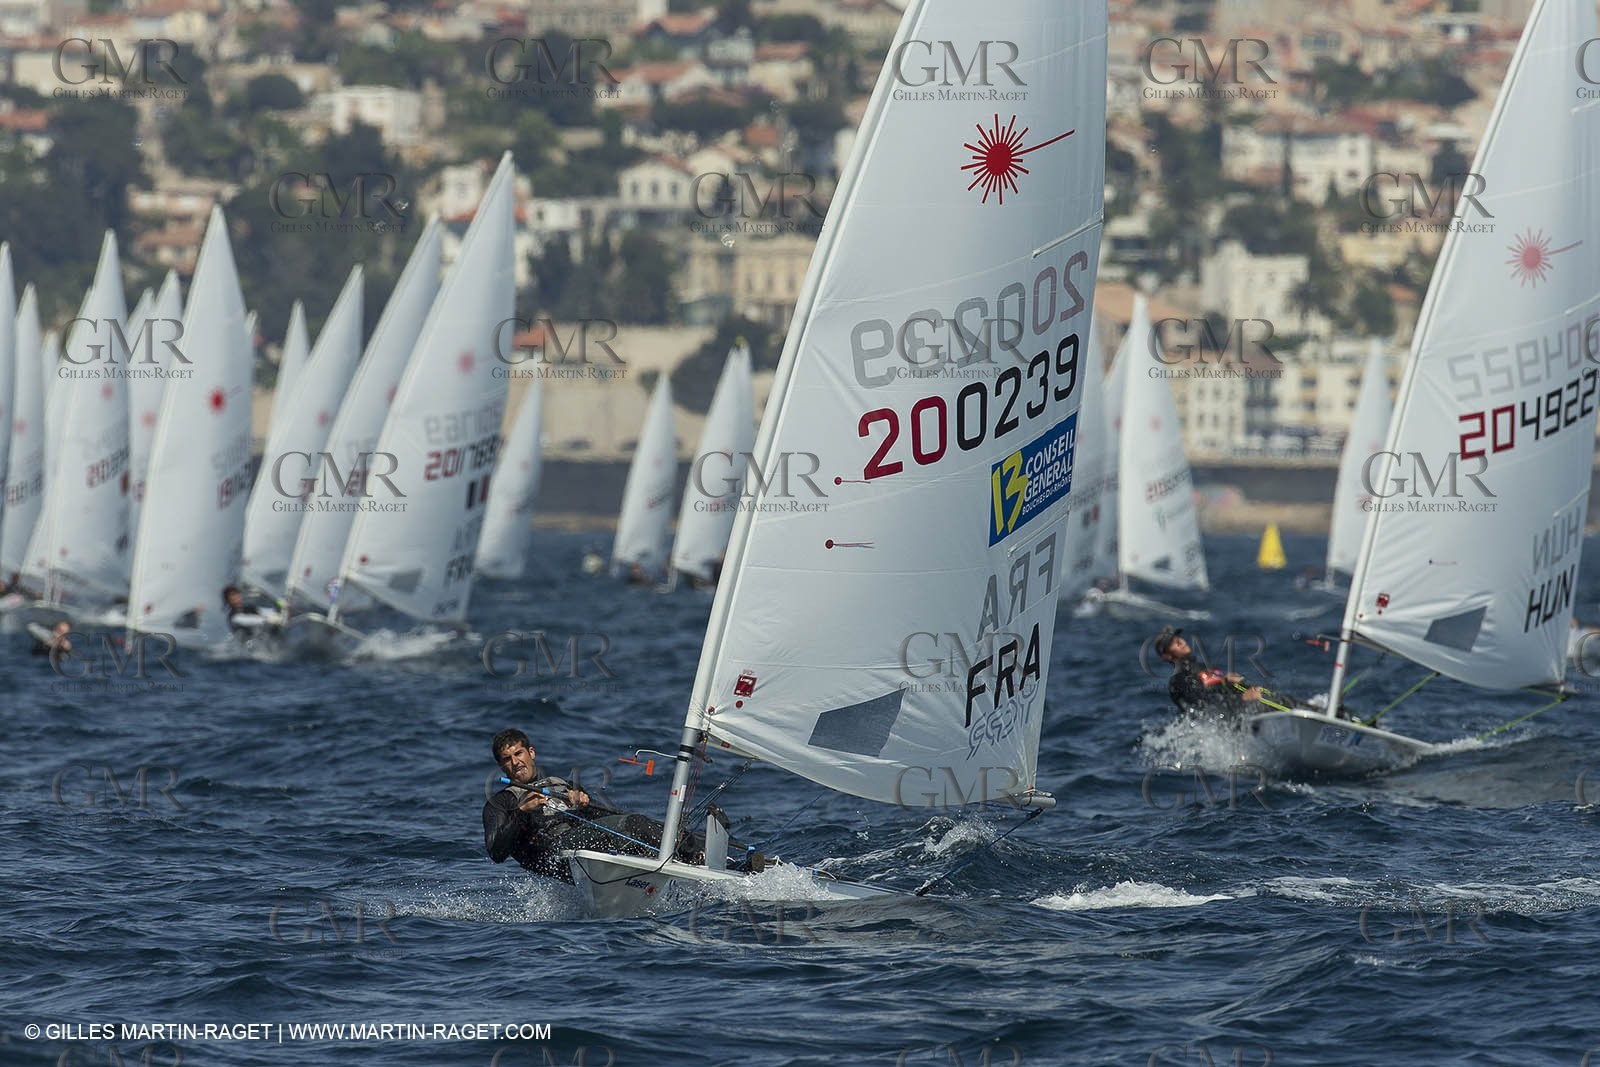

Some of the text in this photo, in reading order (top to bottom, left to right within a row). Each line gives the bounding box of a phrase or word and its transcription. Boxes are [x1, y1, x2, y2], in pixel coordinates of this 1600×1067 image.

[858, 333, 1080, 480] 200239
[1458, 367, 1599, 460] 204922
[1024, 452, 1072, 502] GENERAL
[1025, 428, 1074, 478] CONSEIL
[1523, 564, 1576, 633] HUN
[964, 622, 1041, 729] FRA
